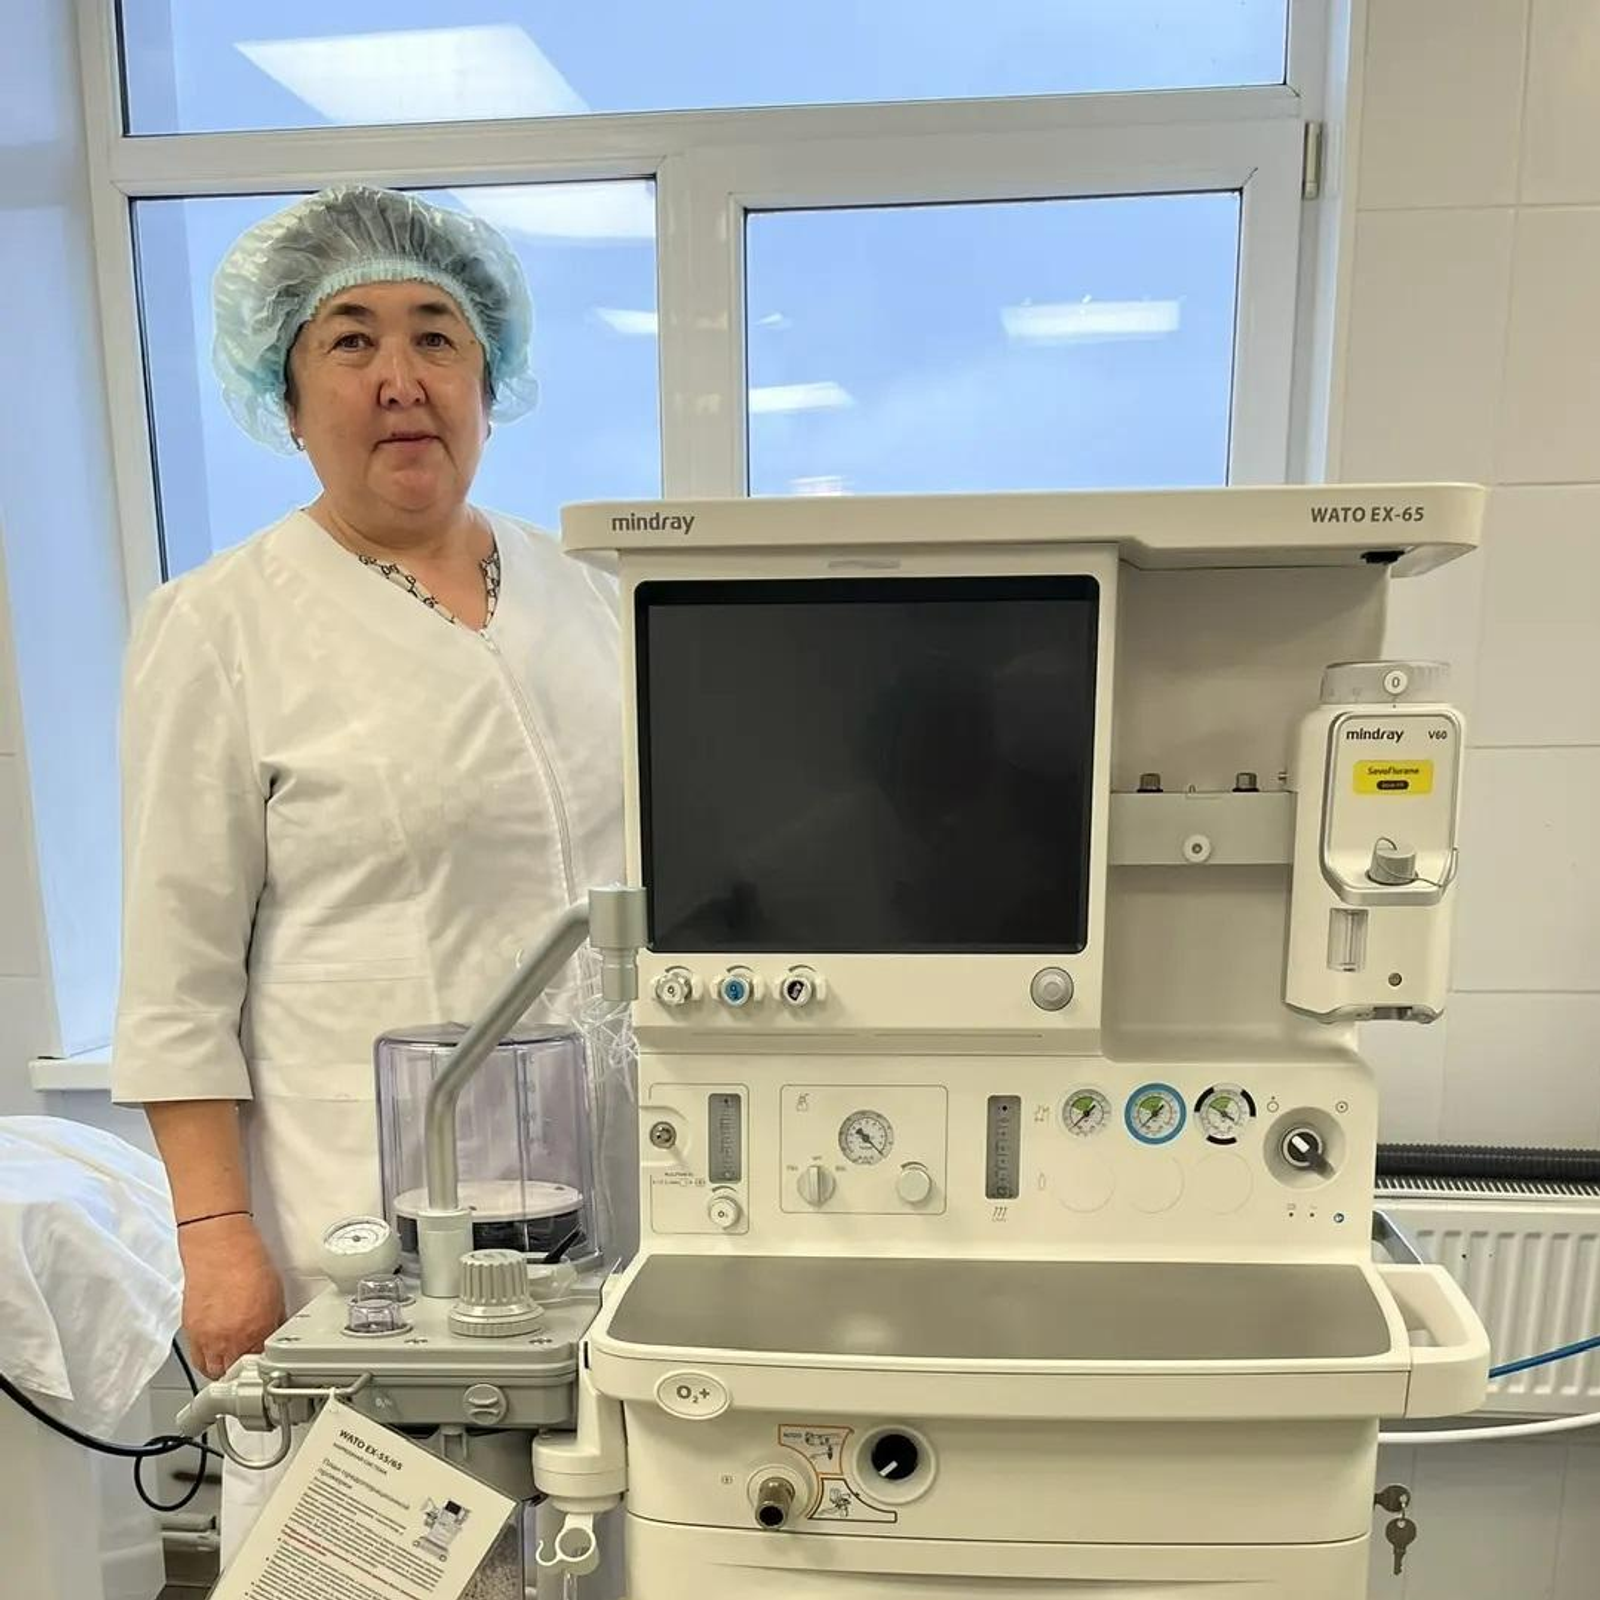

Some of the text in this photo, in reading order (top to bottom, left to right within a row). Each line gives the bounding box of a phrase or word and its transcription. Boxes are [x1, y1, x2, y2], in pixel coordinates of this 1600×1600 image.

[1311, 506, 1424, 523] WATO EX-65
[612, 512, 695, 535] mindray
[1346, 727, 1404, 744] mindray
[1427, 730, 1448, 740] V60
[339, 1429, 403, 1471] WATO EX-55/65
